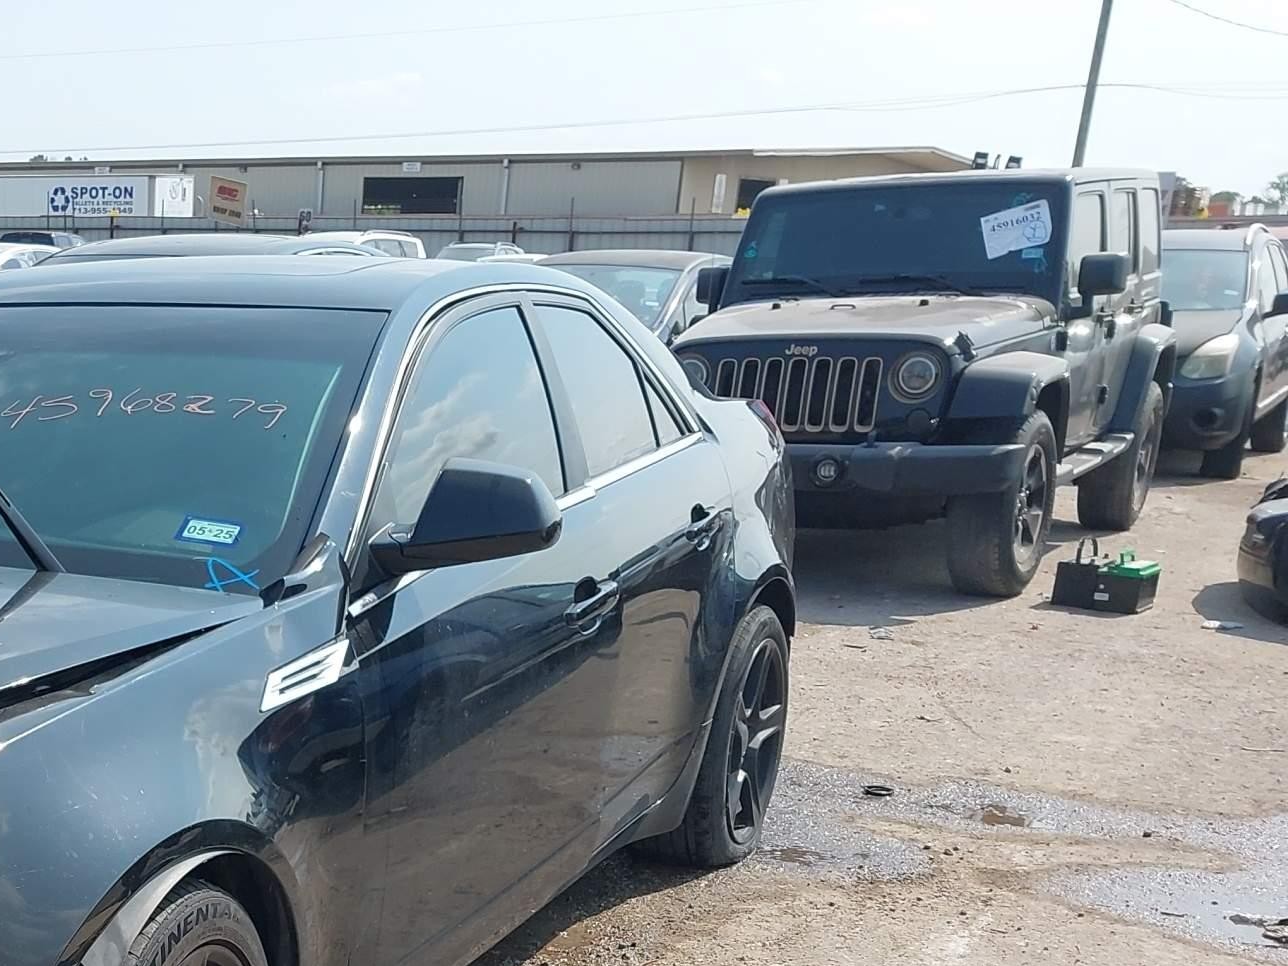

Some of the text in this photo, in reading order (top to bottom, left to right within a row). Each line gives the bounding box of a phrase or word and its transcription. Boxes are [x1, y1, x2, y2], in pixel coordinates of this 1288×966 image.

[70, 186, 134, 200] SPOT-ON
[990, 211, 1042, 232] 45916032
[784, 343, 818, 357] Jeep
[0, 387, 288, 430] 45968279
